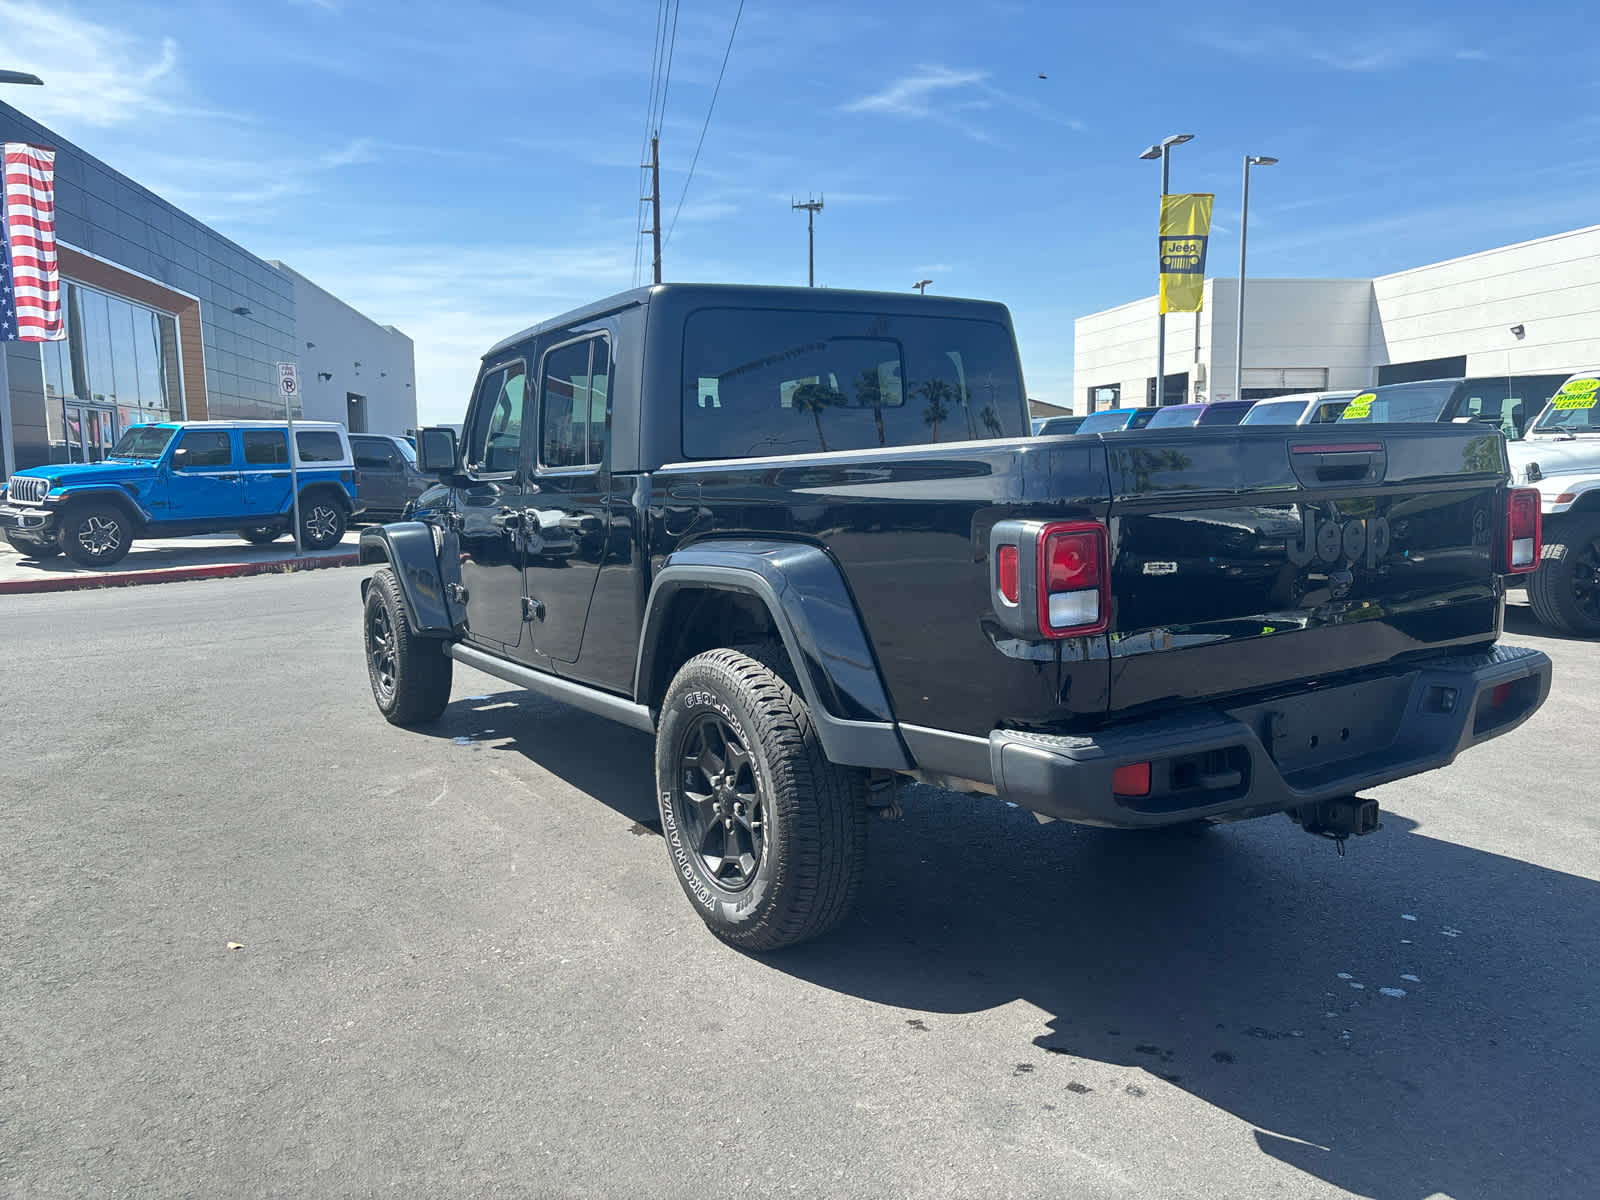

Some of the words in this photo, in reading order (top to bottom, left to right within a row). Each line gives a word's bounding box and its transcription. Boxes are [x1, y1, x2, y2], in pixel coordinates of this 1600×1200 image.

[1168, 242, 1197, 254] Jeep
[1556, 393, 1593, 401] HYBRID
[1555, 400, 1594, 409] LEATHER
[1287, 509, 1391, 569] Jeep
[662, 791, 717, 911] YOKOHAMA
